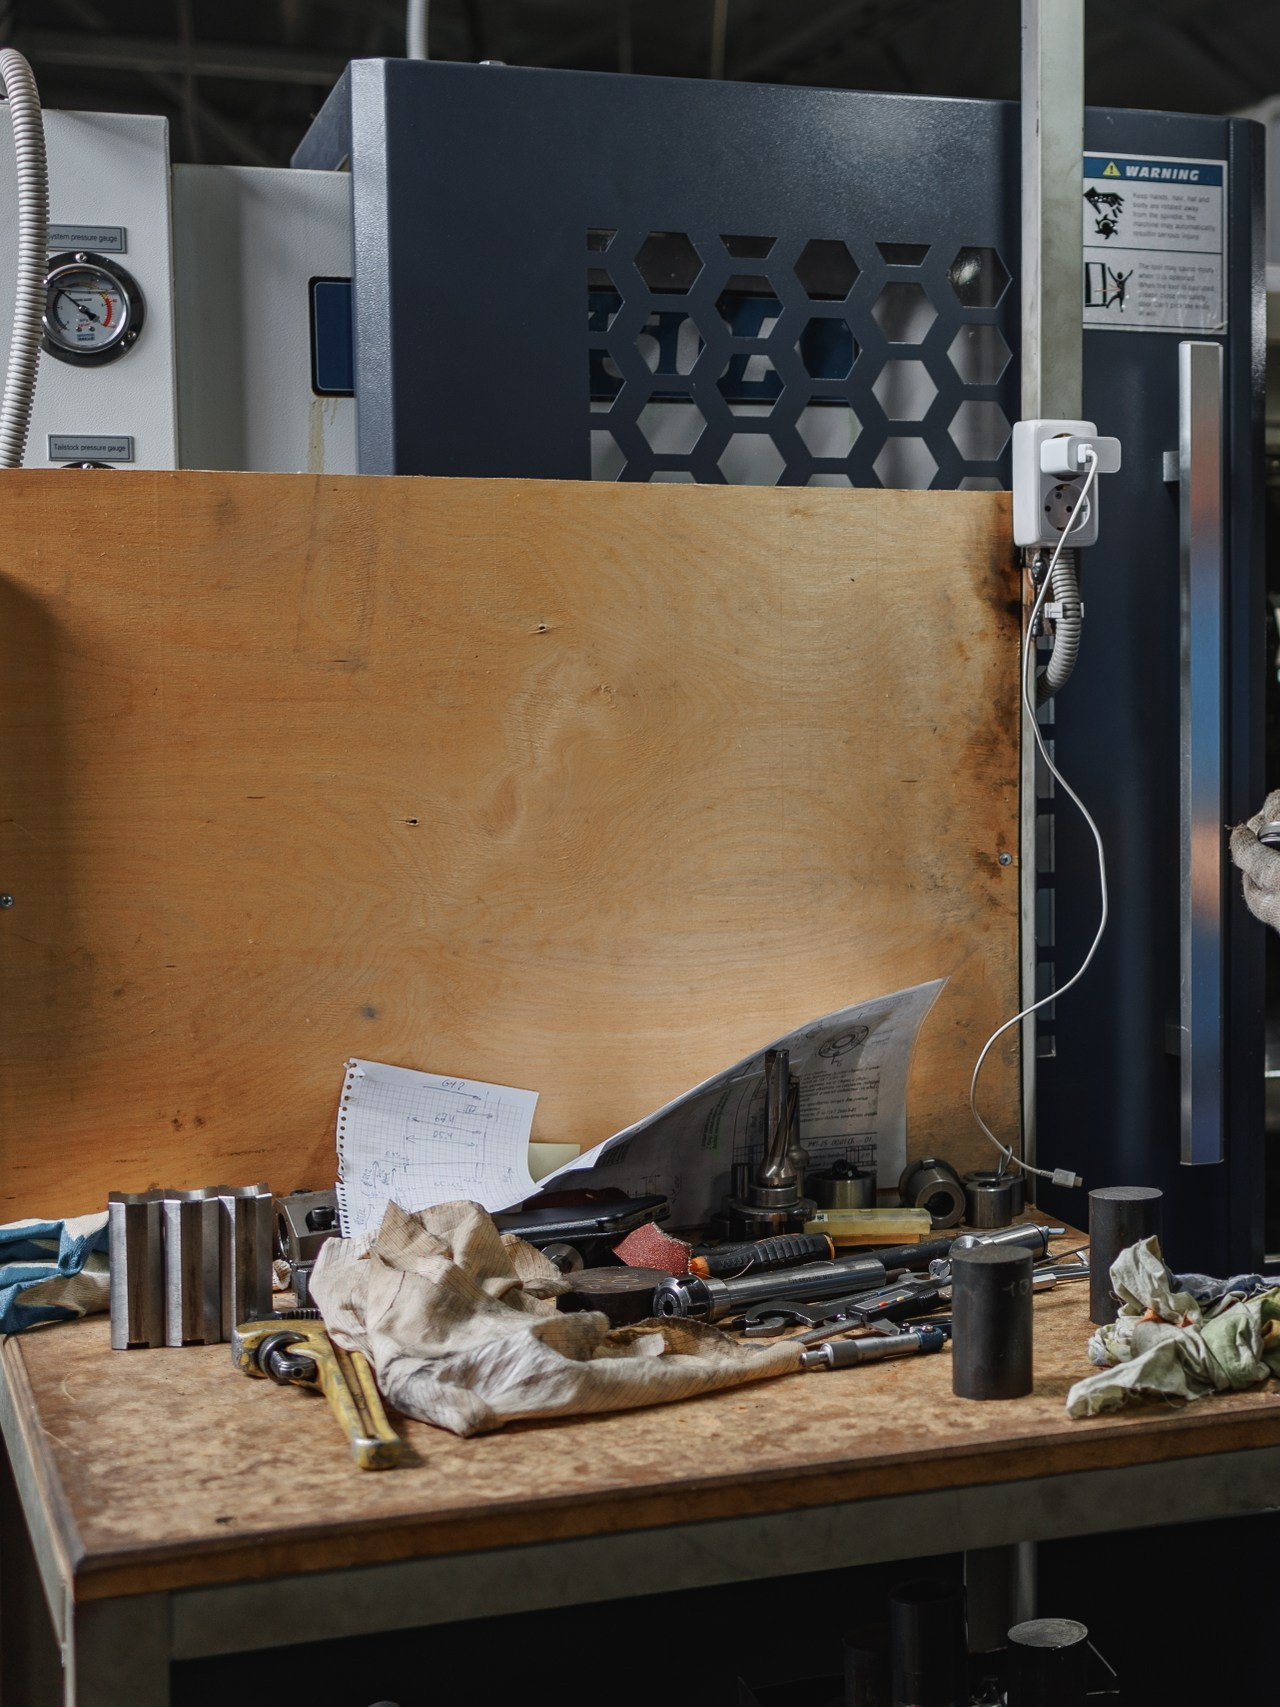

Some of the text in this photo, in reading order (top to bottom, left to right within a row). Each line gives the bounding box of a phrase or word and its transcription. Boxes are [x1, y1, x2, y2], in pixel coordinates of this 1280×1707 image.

[1125, 165, 1200, 181] WARNING
[71, 234, 97, 242] pressure
[99, 235, 118, 243] gauge
[53, 443, 80, 451] Tailstock
